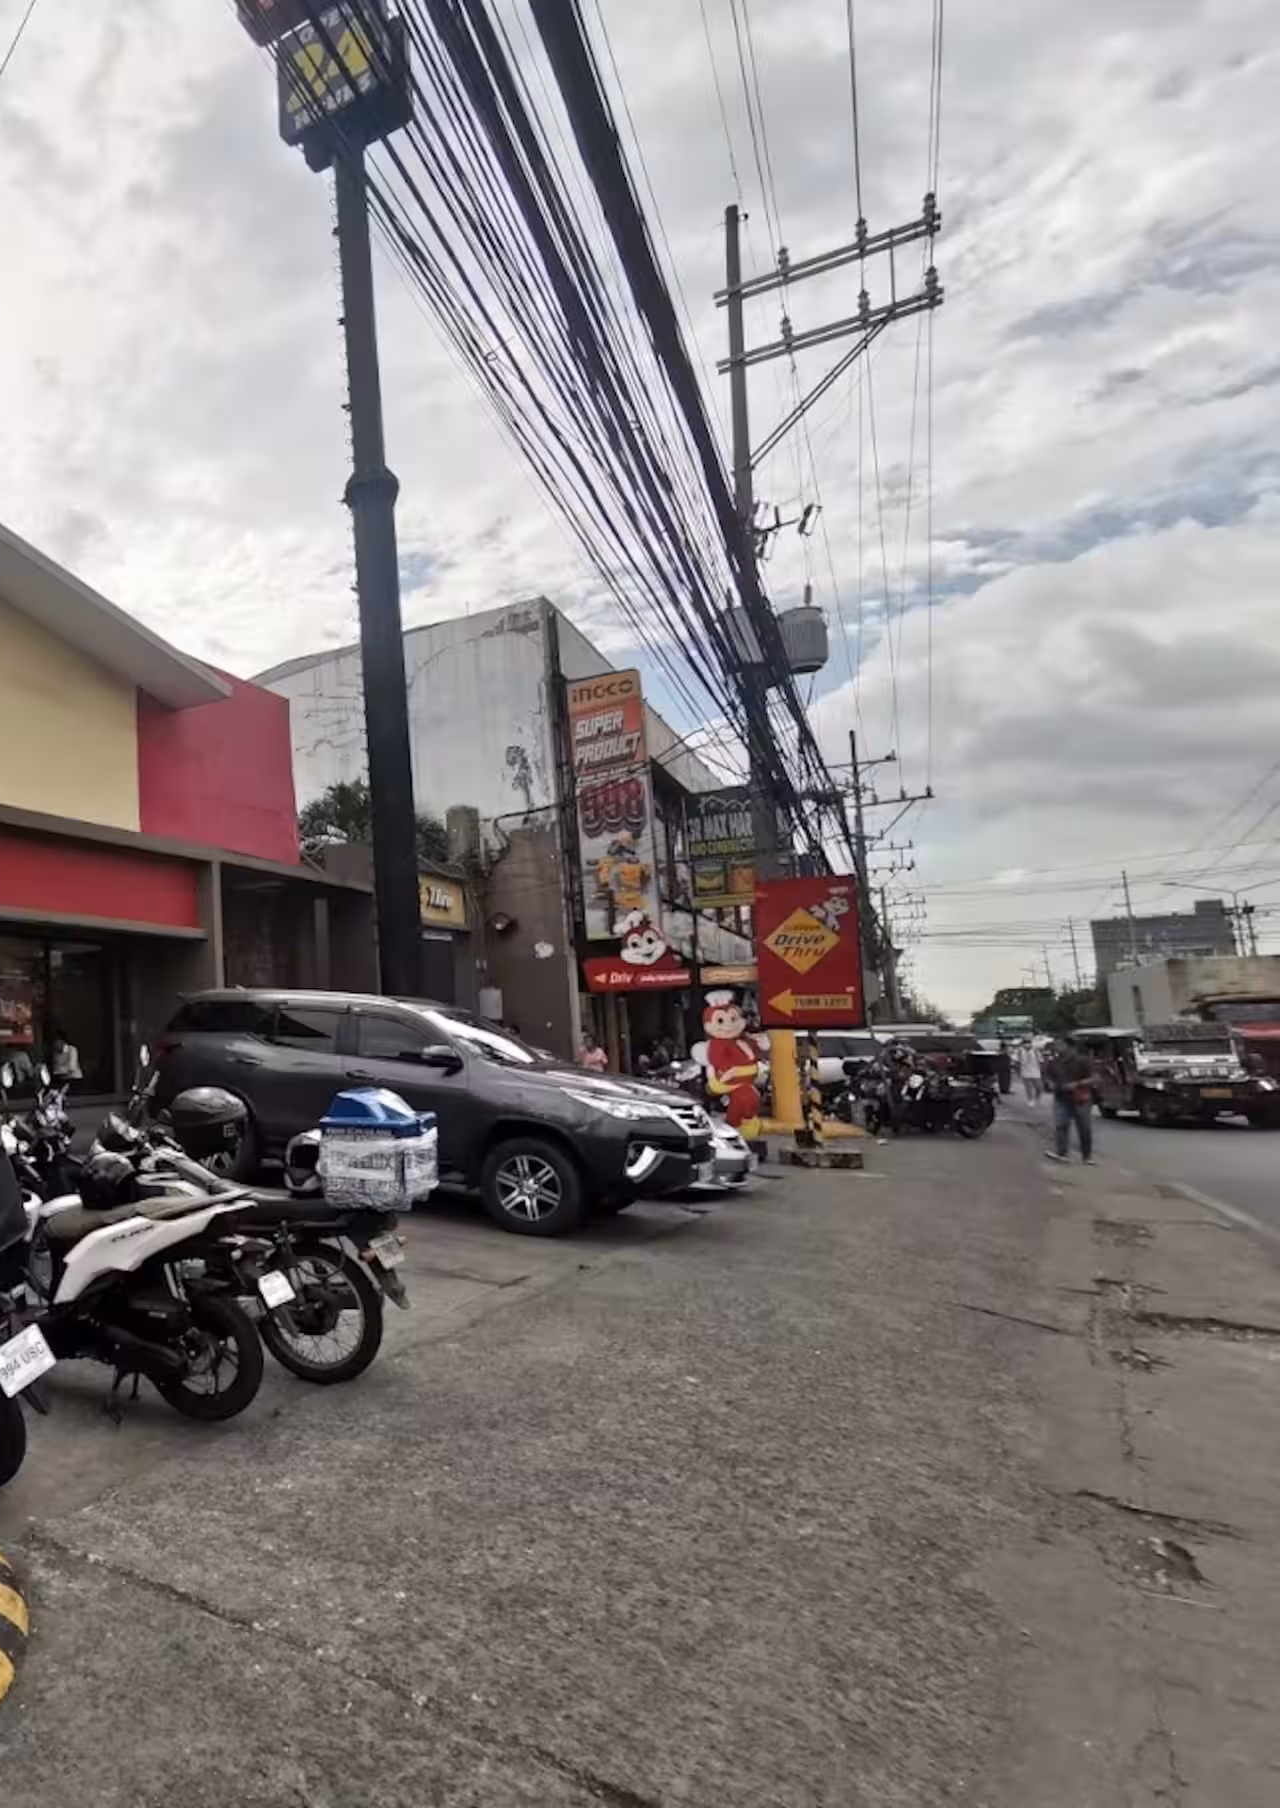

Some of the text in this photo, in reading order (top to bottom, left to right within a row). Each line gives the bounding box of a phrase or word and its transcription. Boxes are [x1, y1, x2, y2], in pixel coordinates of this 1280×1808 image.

[575, 710, 624, 738] SUPER
[575, 731, 641, 765] PRODUCT
[774, 933, 825, 945] Drive
[782, 946, 827, 957] Thru
